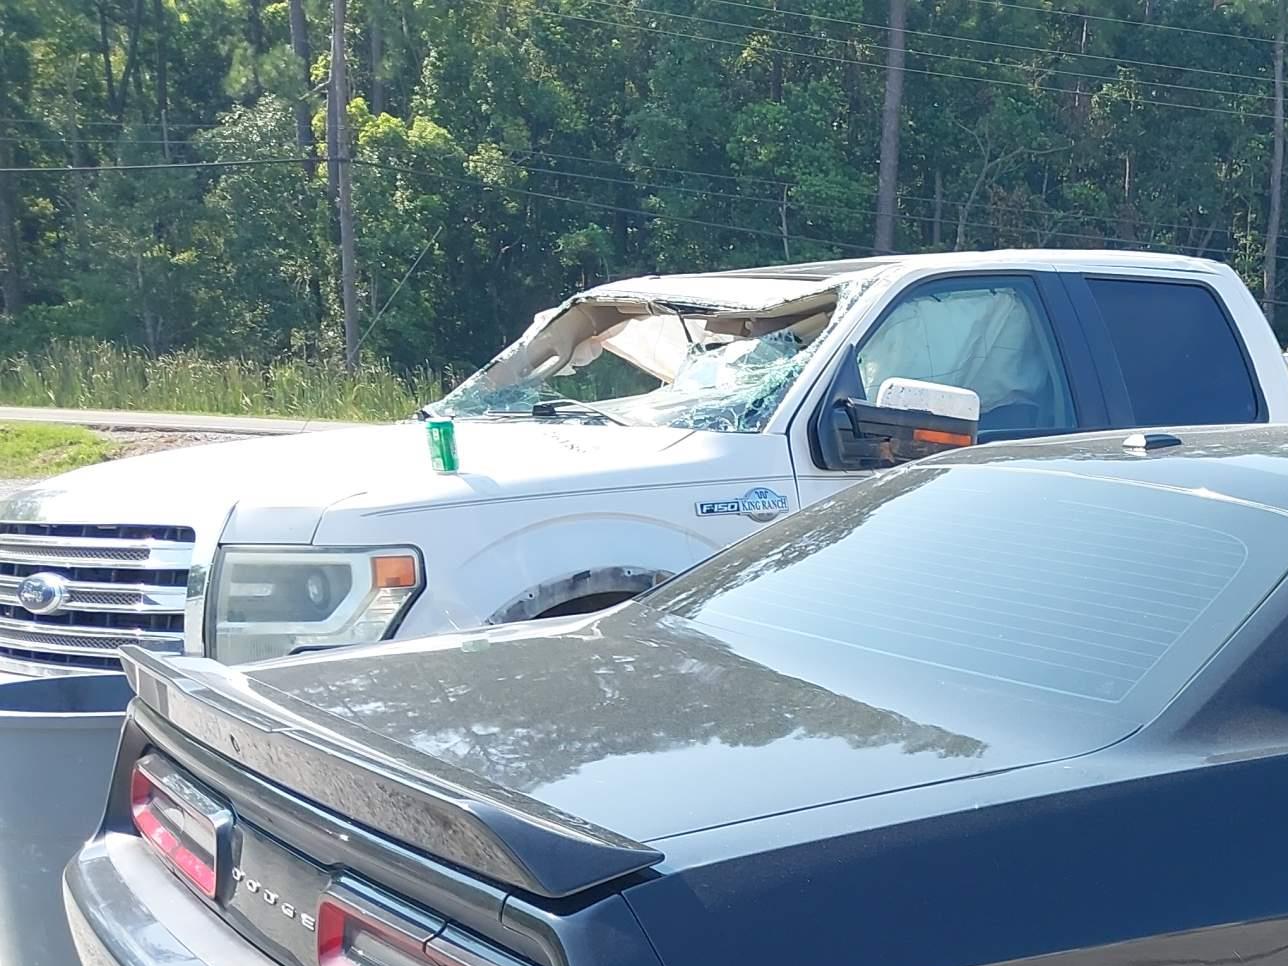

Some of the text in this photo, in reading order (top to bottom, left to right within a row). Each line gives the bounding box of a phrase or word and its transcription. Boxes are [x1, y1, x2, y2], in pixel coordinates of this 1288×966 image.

[702, 503, 738, 513] F-150
[742, 499, 787, 512] KING RANCH
[232, 866, 316, 931] DODGE
